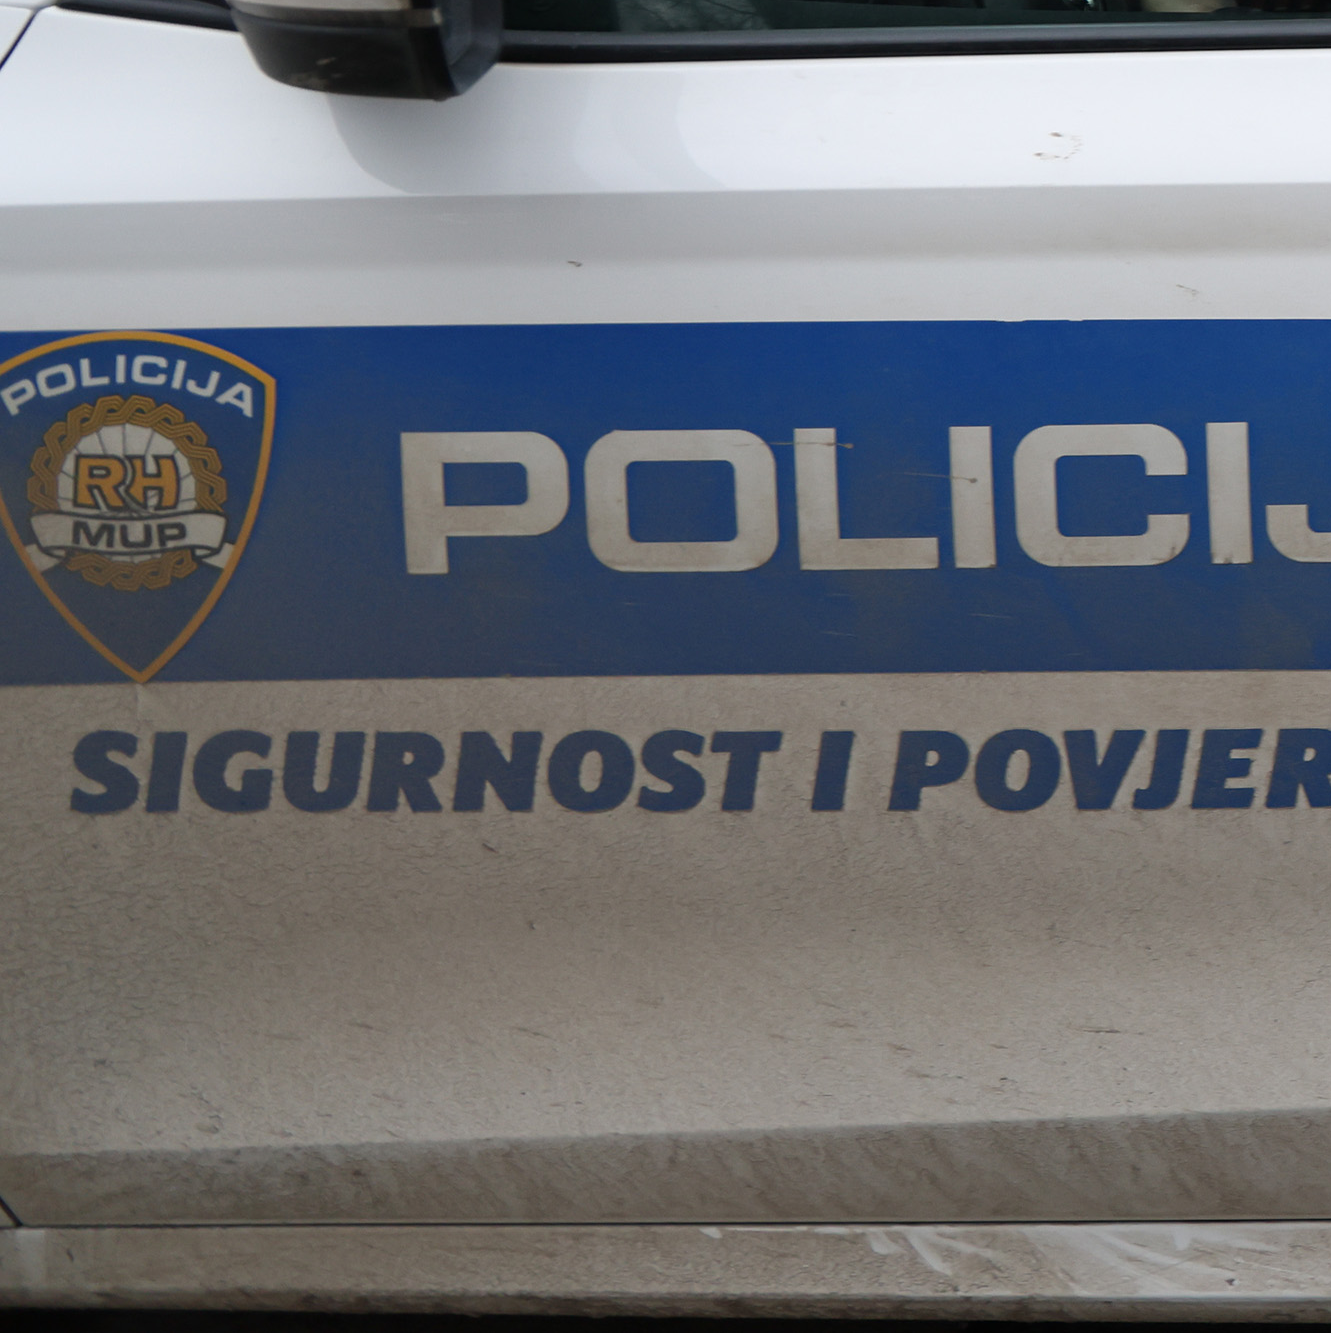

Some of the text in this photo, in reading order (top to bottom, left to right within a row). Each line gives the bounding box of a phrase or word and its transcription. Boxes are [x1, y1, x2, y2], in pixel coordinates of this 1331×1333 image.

[0, 354, 254, 419] POLICIJA
[74, 454, 179, 511] RH
[71, 520, 188, 549] MUP
[71, 729, 784, 814] SIGURNOST
[811, 730, 855, 812] I
